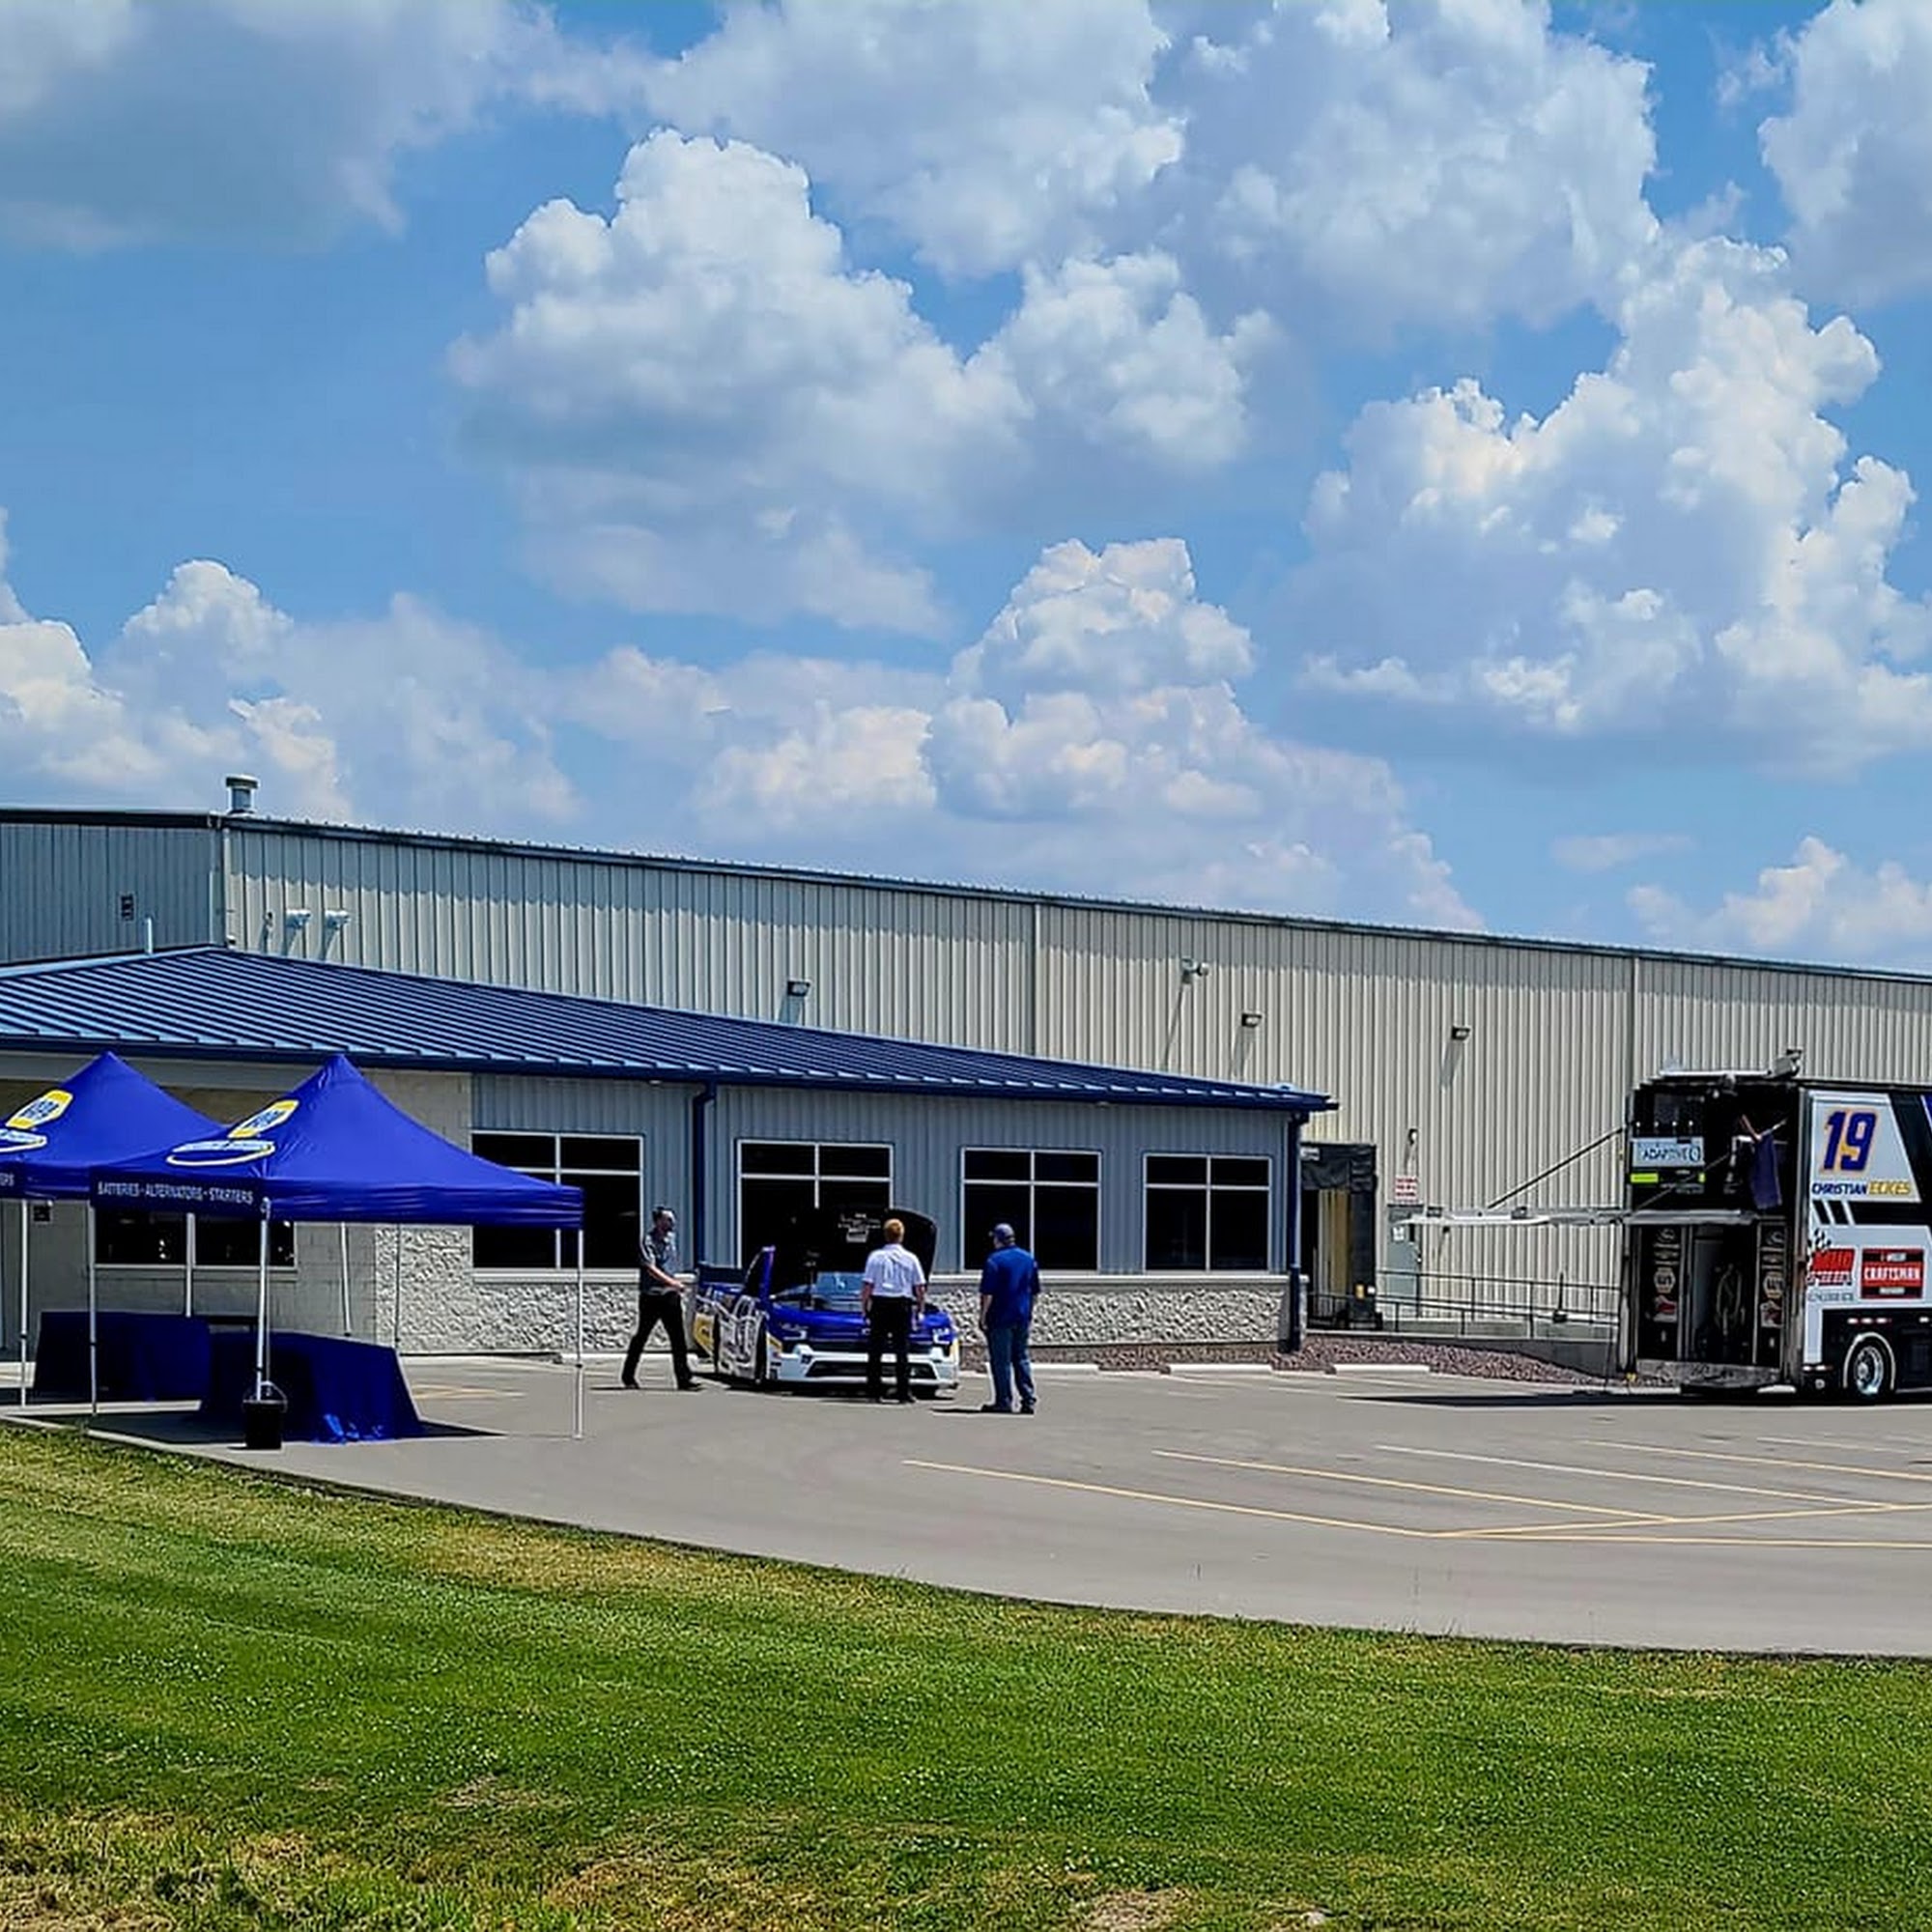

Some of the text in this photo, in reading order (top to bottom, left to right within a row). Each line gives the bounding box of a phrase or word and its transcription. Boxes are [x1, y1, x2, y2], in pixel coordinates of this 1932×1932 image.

[1821, 1109, 1877, 1173] 19
[210, 1187, 254, 1205] STARTERS
[1811, 1182, 1867, 1195] CHRISTIAN
[1863, 1266, 1921, 1281] CRAFTSMAN
